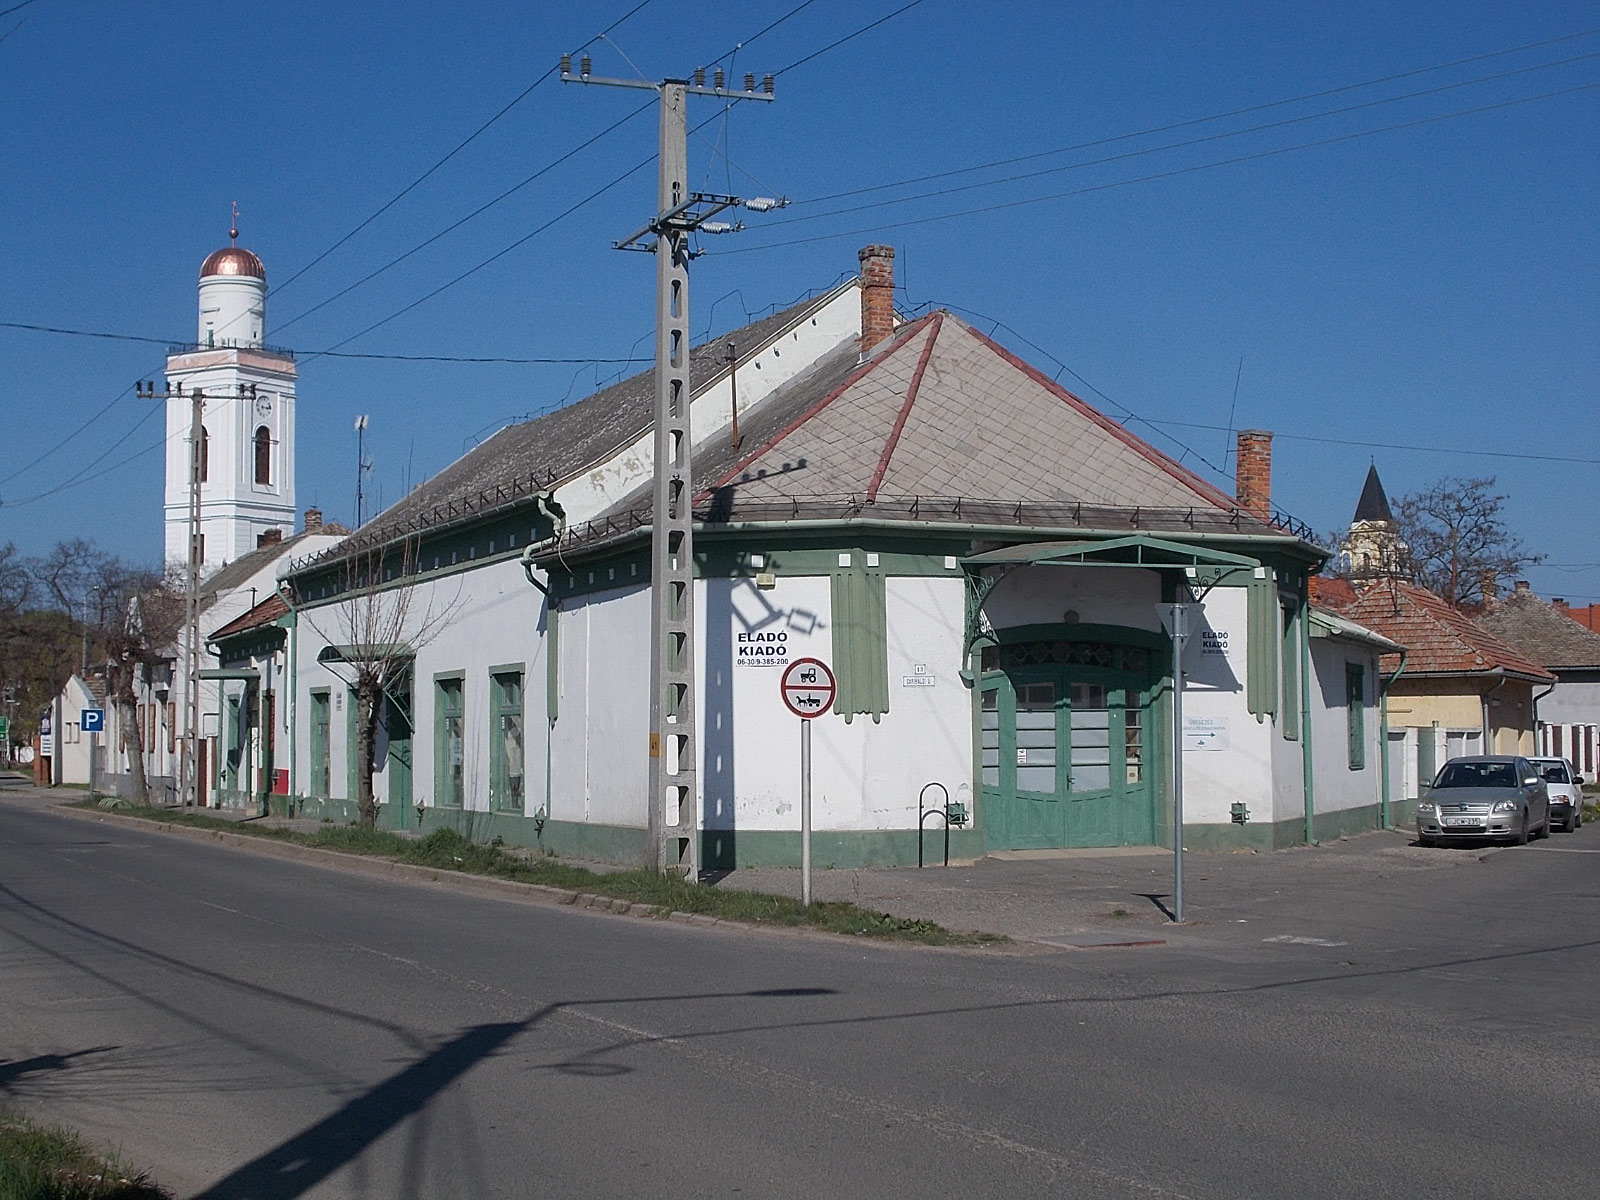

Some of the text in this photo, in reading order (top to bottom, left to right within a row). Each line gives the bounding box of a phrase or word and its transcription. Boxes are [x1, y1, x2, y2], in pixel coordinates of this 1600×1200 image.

[738, 630, 788, 642] ELADÓ
[1202, 631, 1229, 639] ELADÓ
[739, 643, 787, 656] KIADÓ
[1202, 640, 1228, 648] KIADÓ
[86, 712, 99, 729] P
